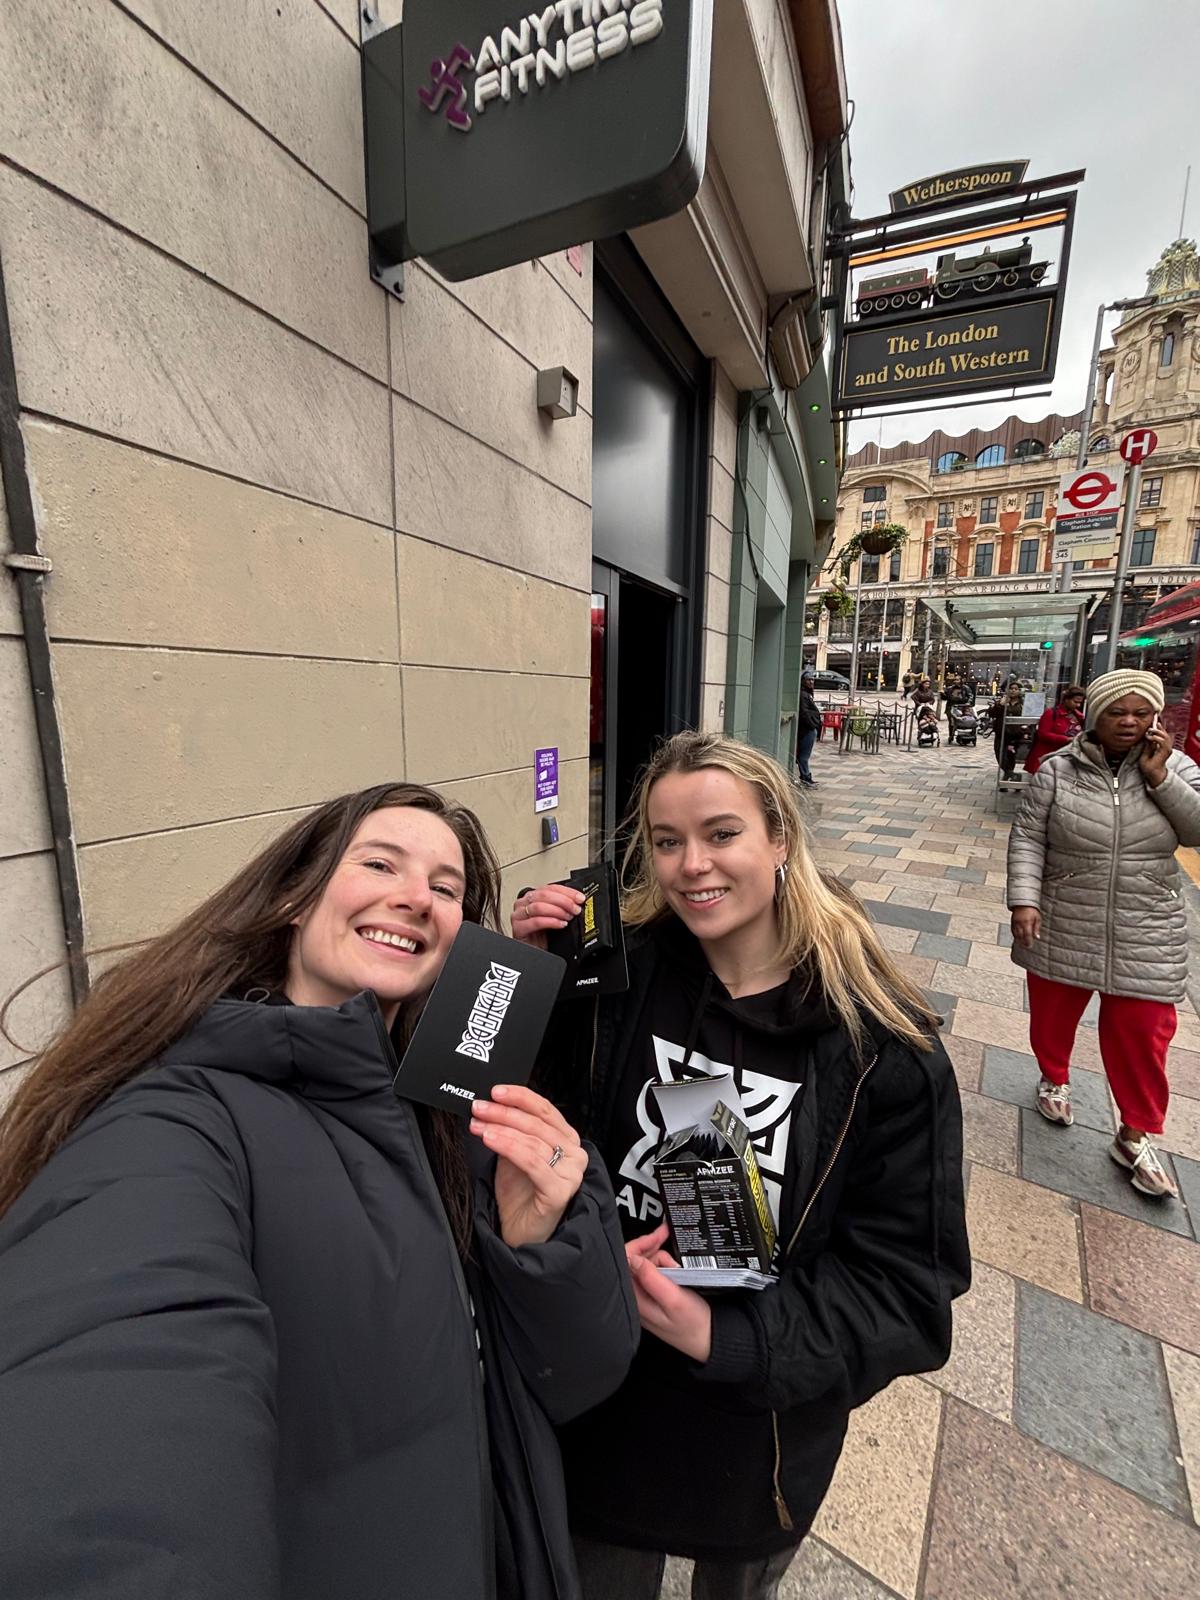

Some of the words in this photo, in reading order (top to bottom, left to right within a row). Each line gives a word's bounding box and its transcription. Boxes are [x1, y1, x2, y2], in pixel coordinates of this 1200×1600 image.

[475, 0, 641, 75] ANYTIM
[475, 0, 663, 113] FITNESS
[902, 170, 1013, 206] Wetherspoon
[887, 334, 920, 356] The
[924, 323, 999, 350] London
[855, 366, 888, 387] and
[893, 359, 946, 381] South
[949, 347, 1030, 374] Western
[1125, 432, 1151, 458] H
[1061, 519, 1086, 527] Clapham
[1087, 516, 1113, 524] Junction
[974, 584, 1019, 593] ARDING
[439, 1082, 476, 1100] APMZEE
[696, 1165, 735, 1176] APMZEE
